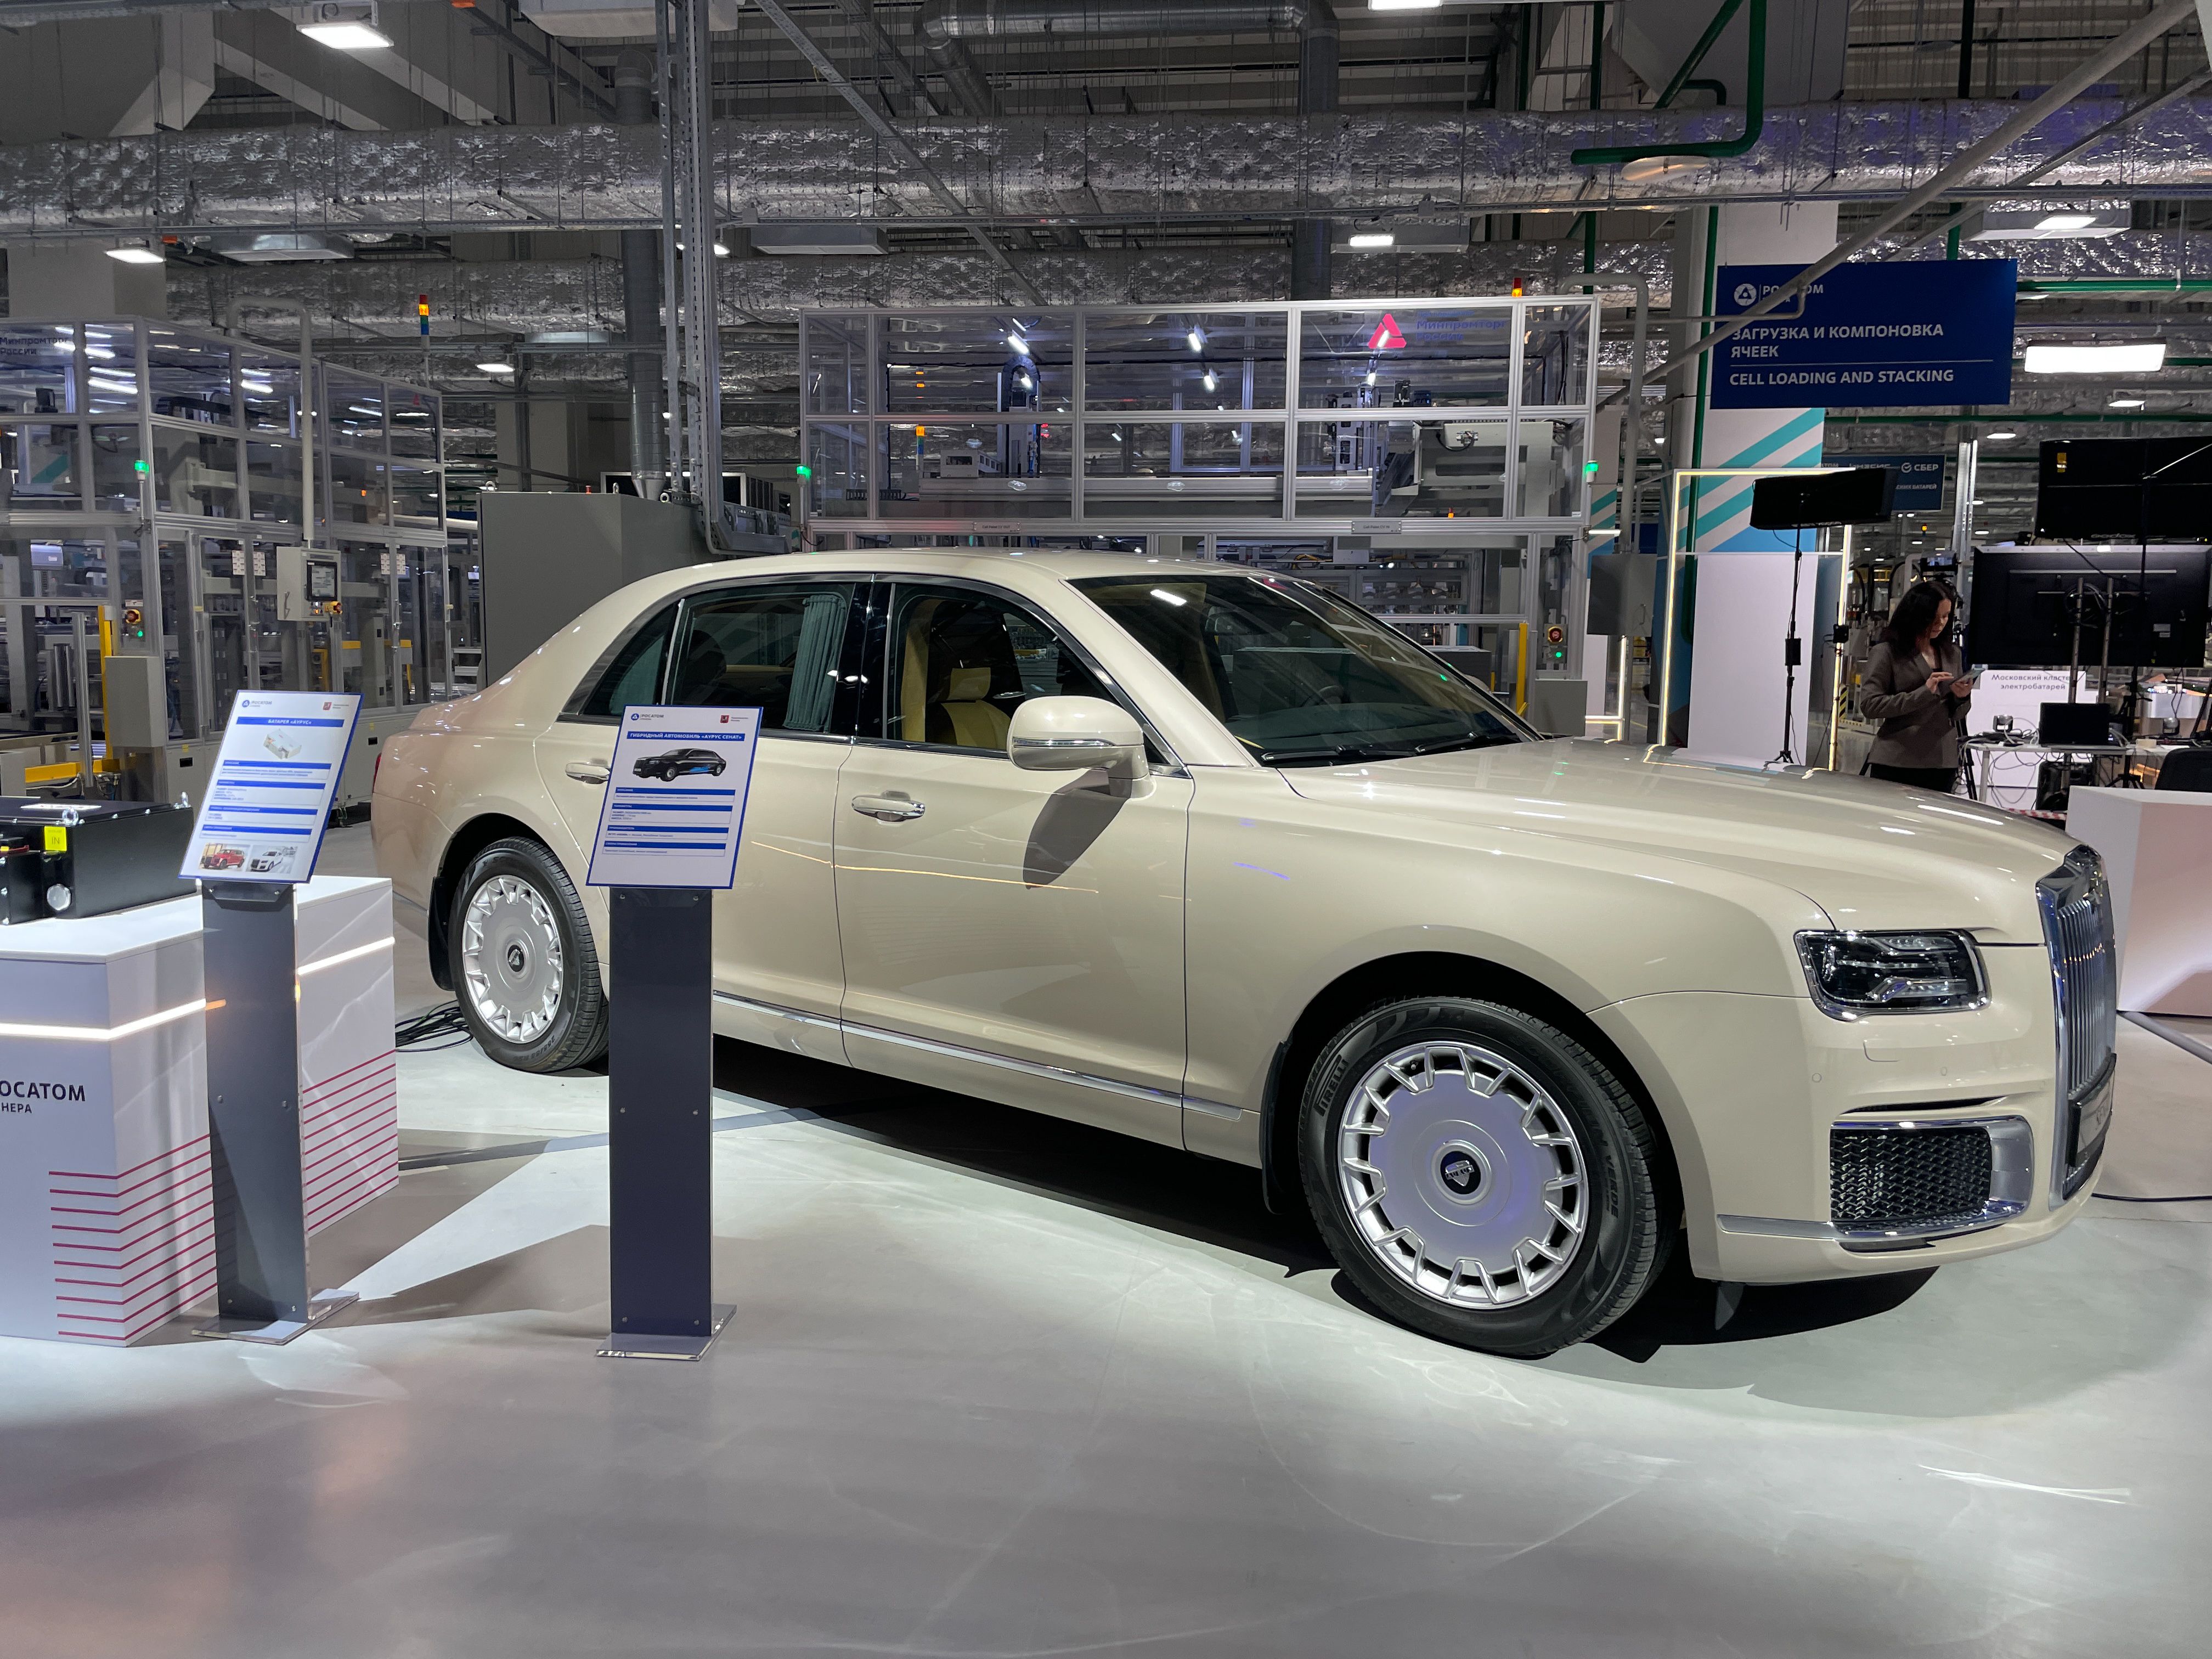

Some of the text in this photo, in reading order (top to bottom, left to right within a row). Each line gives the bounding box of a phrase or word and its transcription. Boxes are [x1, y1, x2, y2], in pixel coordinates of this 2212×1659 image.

[1731, 324, 1944, 341] ЗАГРУЗКА И КОМПОНОВКА
[1731, 346, 1779, 358] ЯЧЕЕК
[1730, 369, 1954, 386] CELL LOADING AND STACKING
[52, 837, 60, 845] IN
[0, 1080, 86, 1102] ОСАТОМ
[1313, 1054, 1348, 1116] PIRELLI
[1, 1102, 32, 1114] НЕРА
[1605, 1154, 1620, 1219] VERDE
